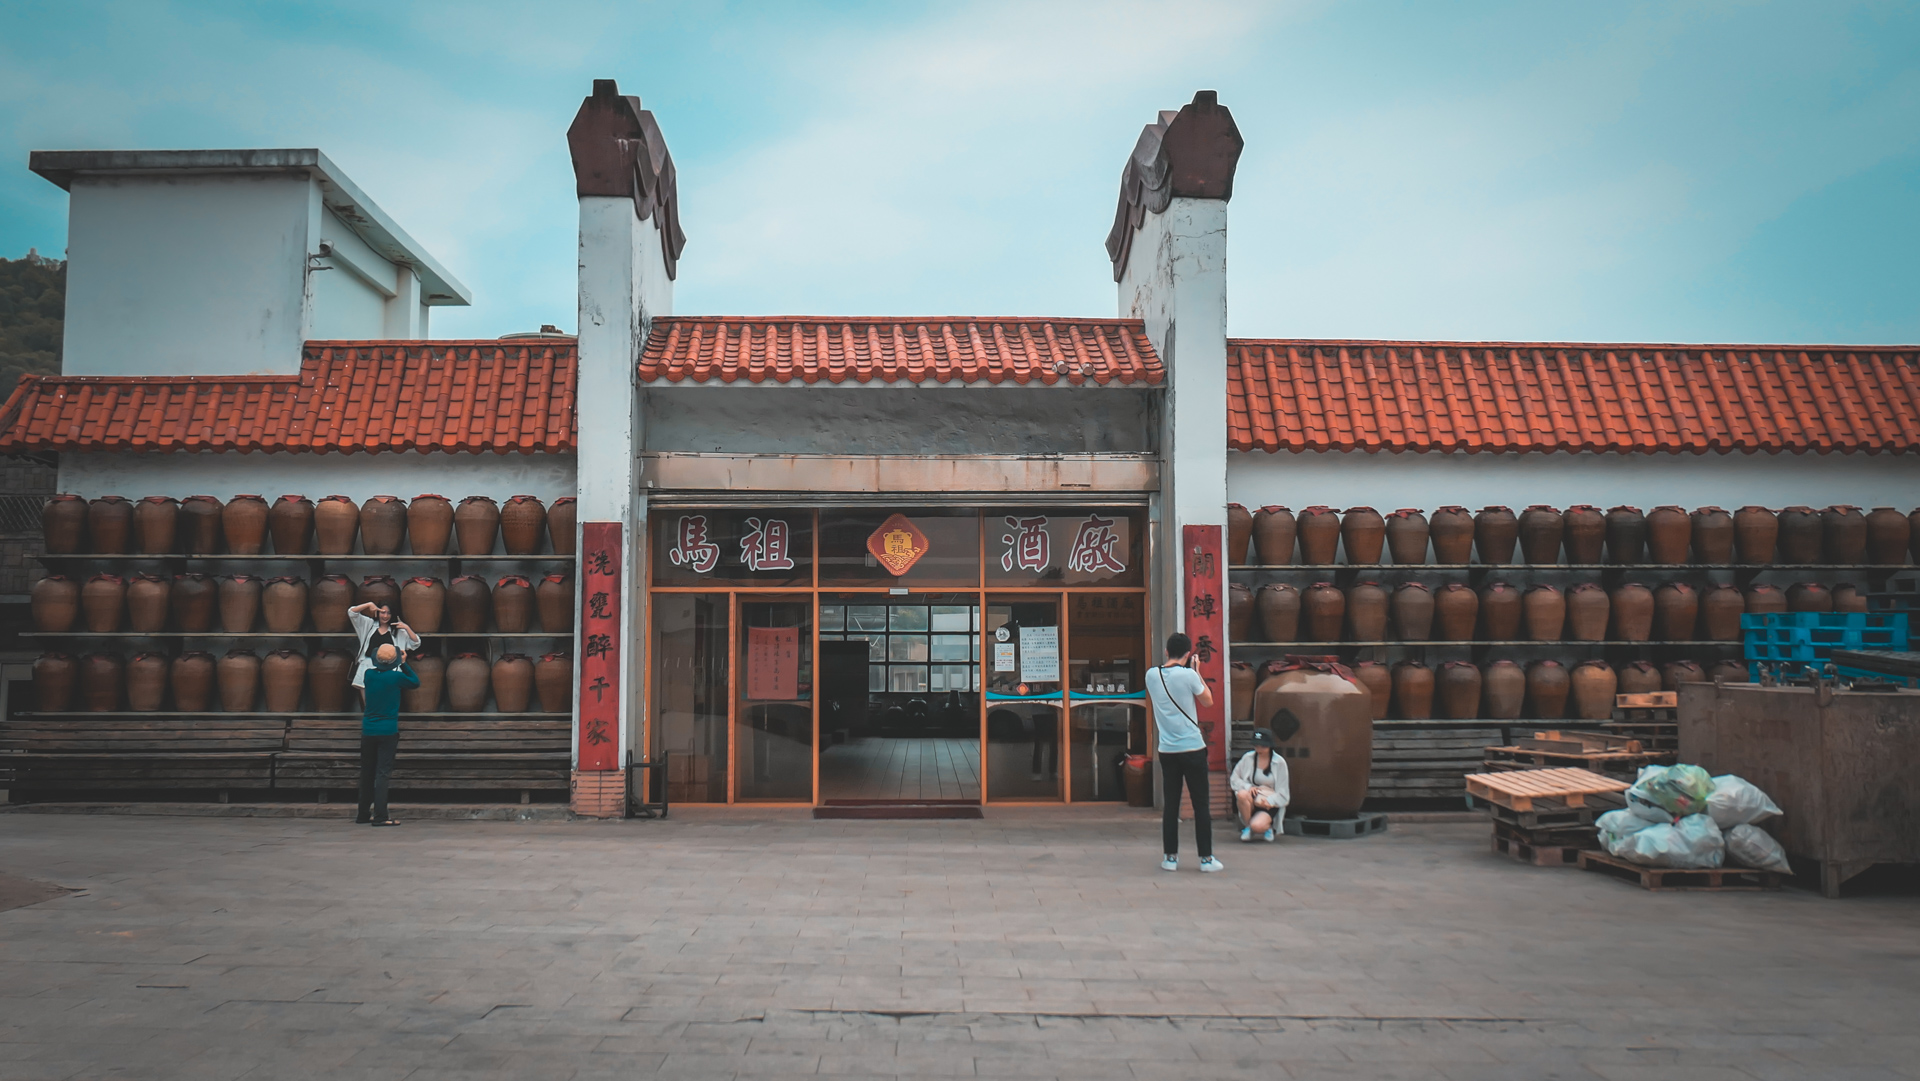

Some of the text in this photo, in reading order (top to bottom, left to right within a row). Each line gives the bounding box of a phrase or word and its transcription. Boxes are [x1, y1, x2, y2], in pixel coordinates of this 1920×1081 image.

[670, 513, 1126, 573] 馬祖 酒廠
[891, 534, 905, 554] 馬祖
